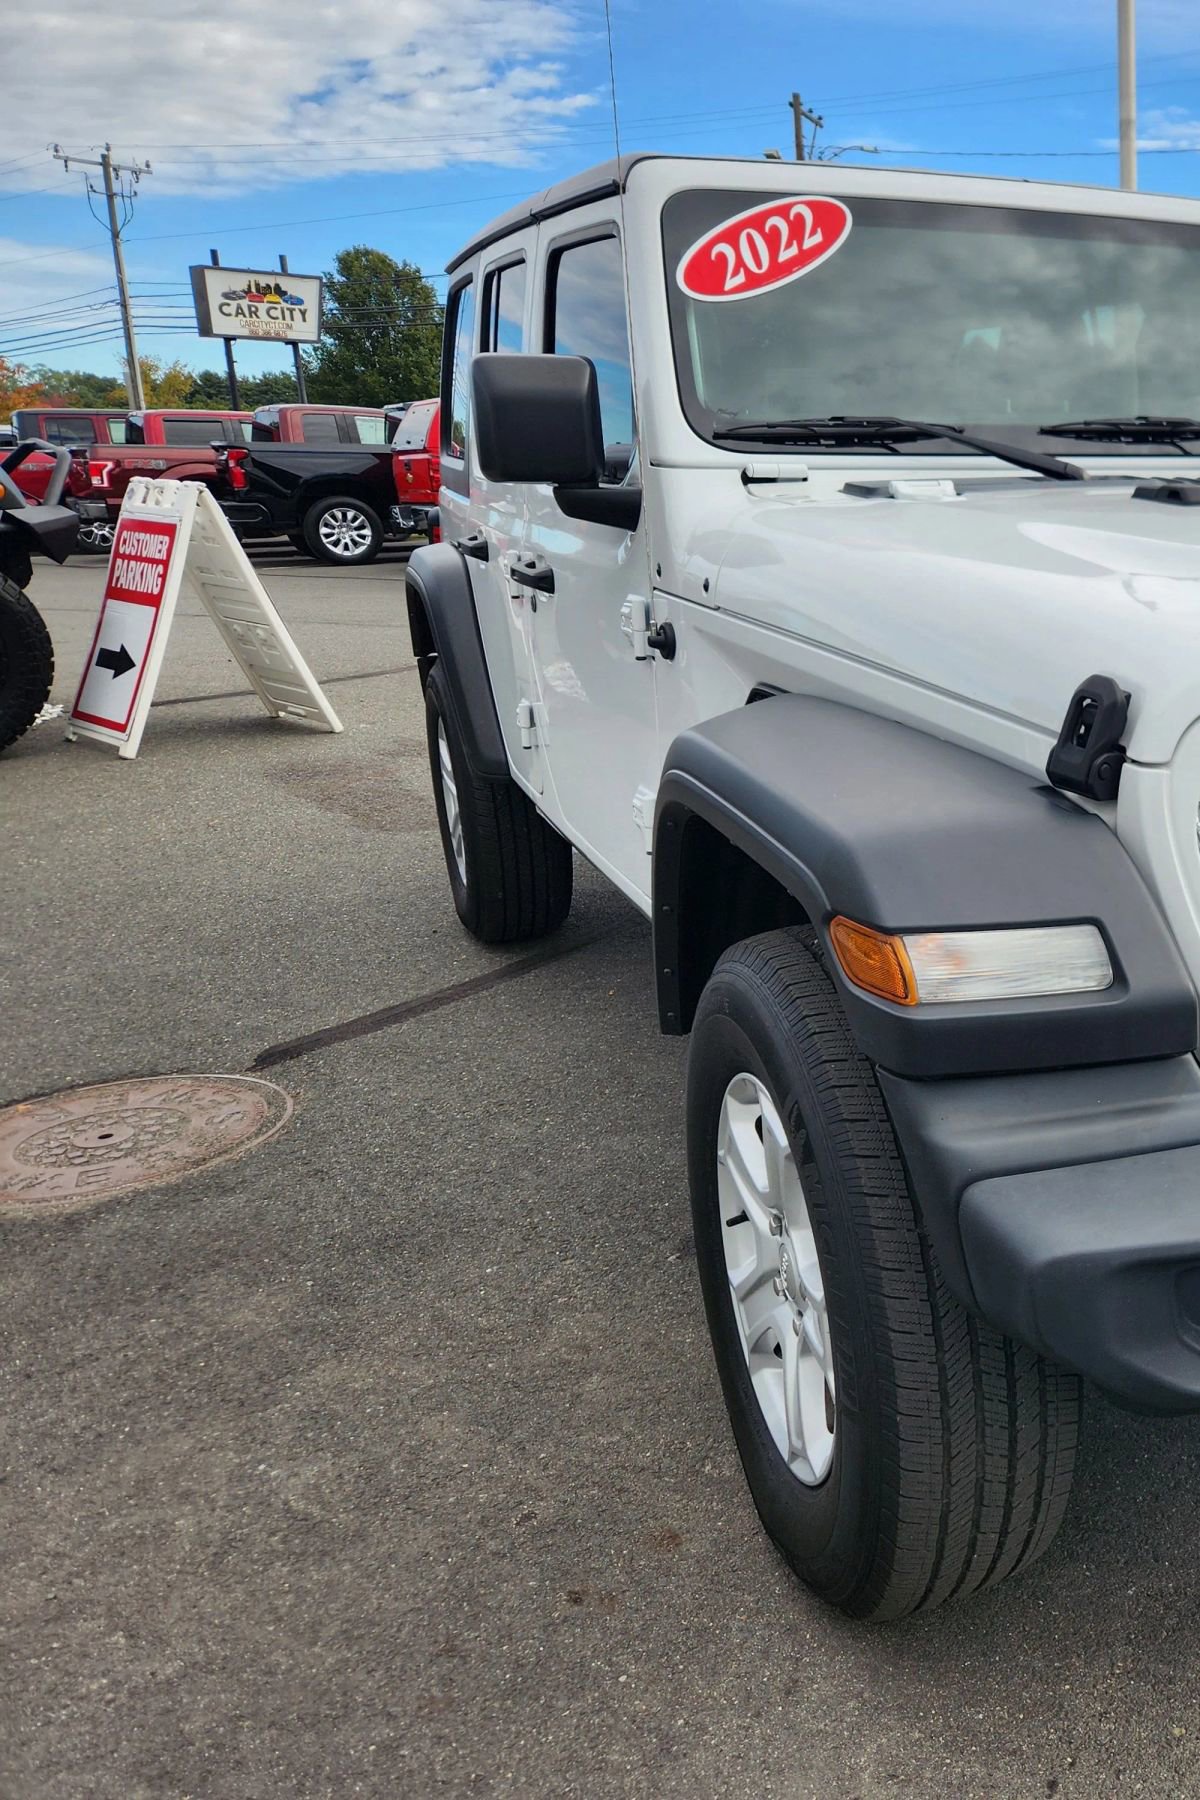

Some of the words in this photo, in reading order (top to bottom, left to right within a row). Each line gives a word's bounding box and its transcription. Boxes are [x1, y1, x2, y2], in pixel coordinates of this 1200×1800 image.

[710, 203, 824, 292] 2022
[218, 302, 260, 319] CAR
[265, 306, 308, 323] CITY
[118, 530, 170, 560] CUSTOMER
[111, 558, 164, 595] PARKING
